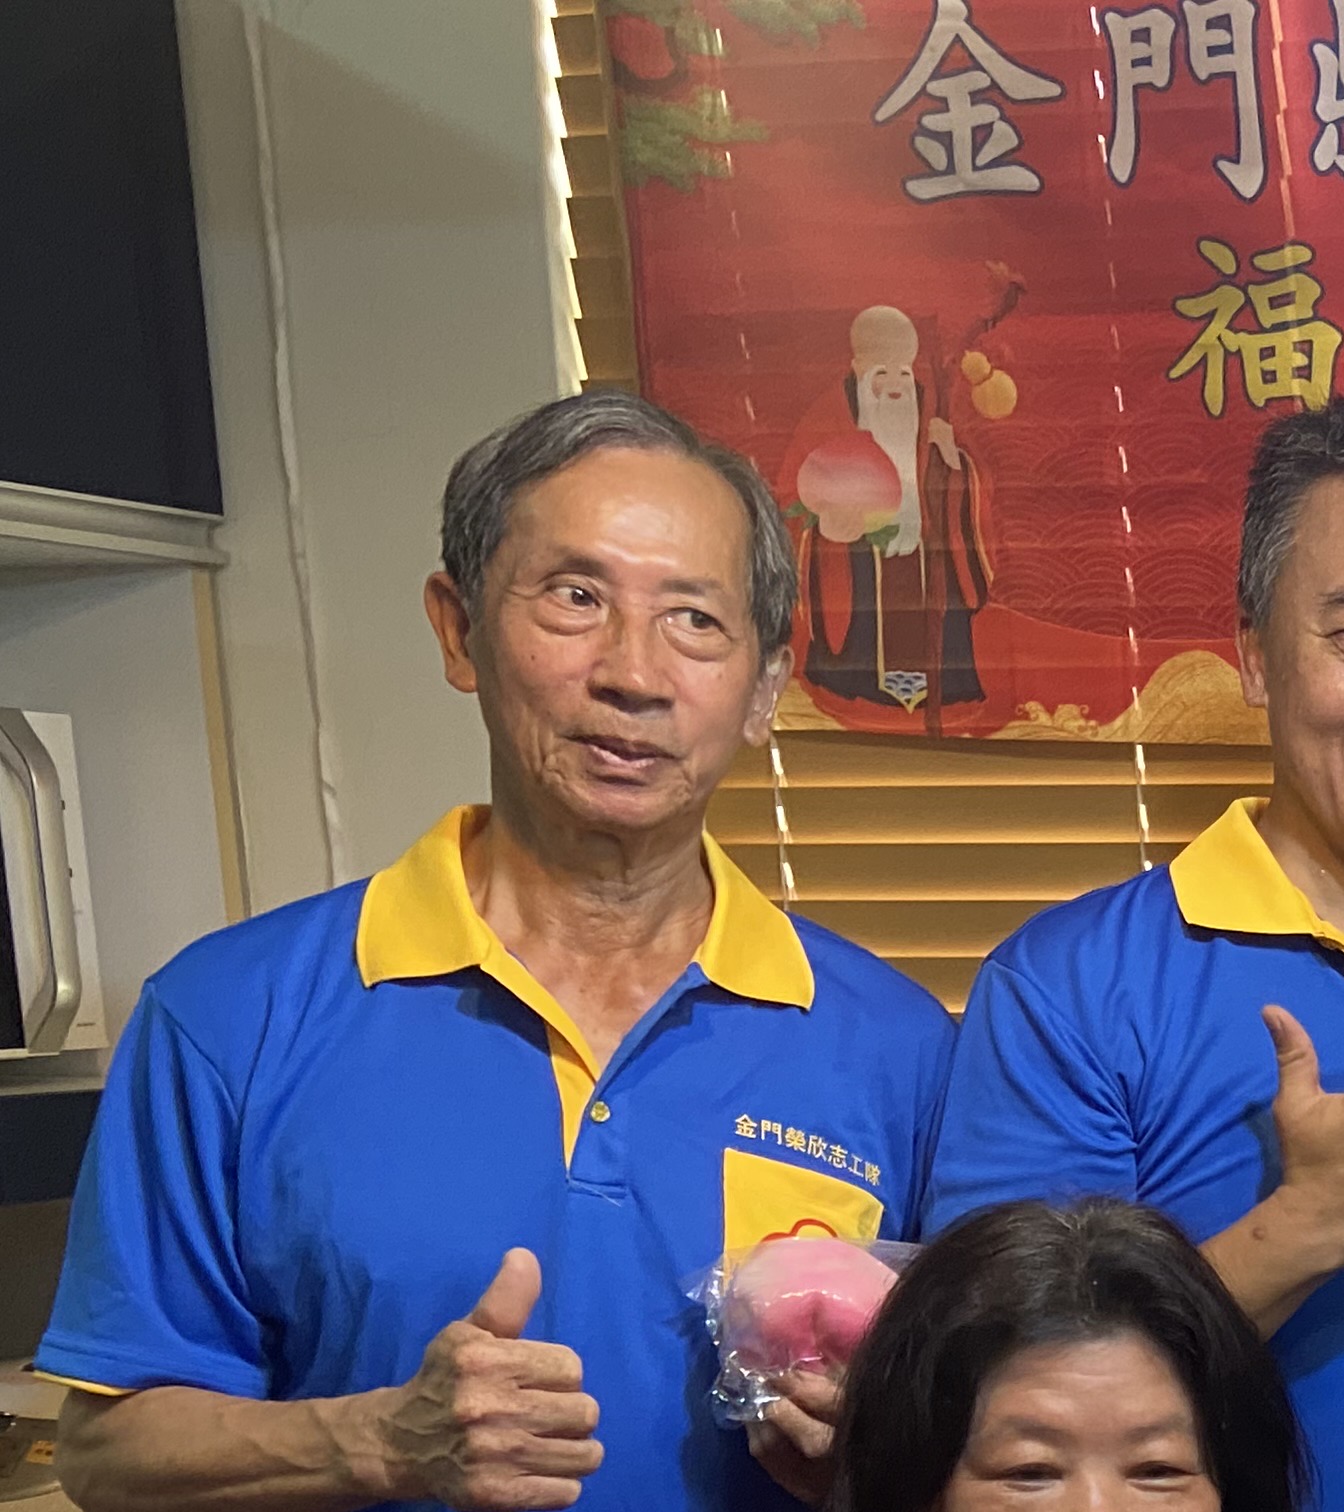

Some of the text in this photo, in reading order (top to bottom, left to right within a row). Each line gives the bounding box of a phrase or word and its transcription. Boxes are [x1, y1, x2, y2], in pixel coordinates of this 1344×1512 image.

[734, 1113, 882, 1187] 金門榮欣志工隊
